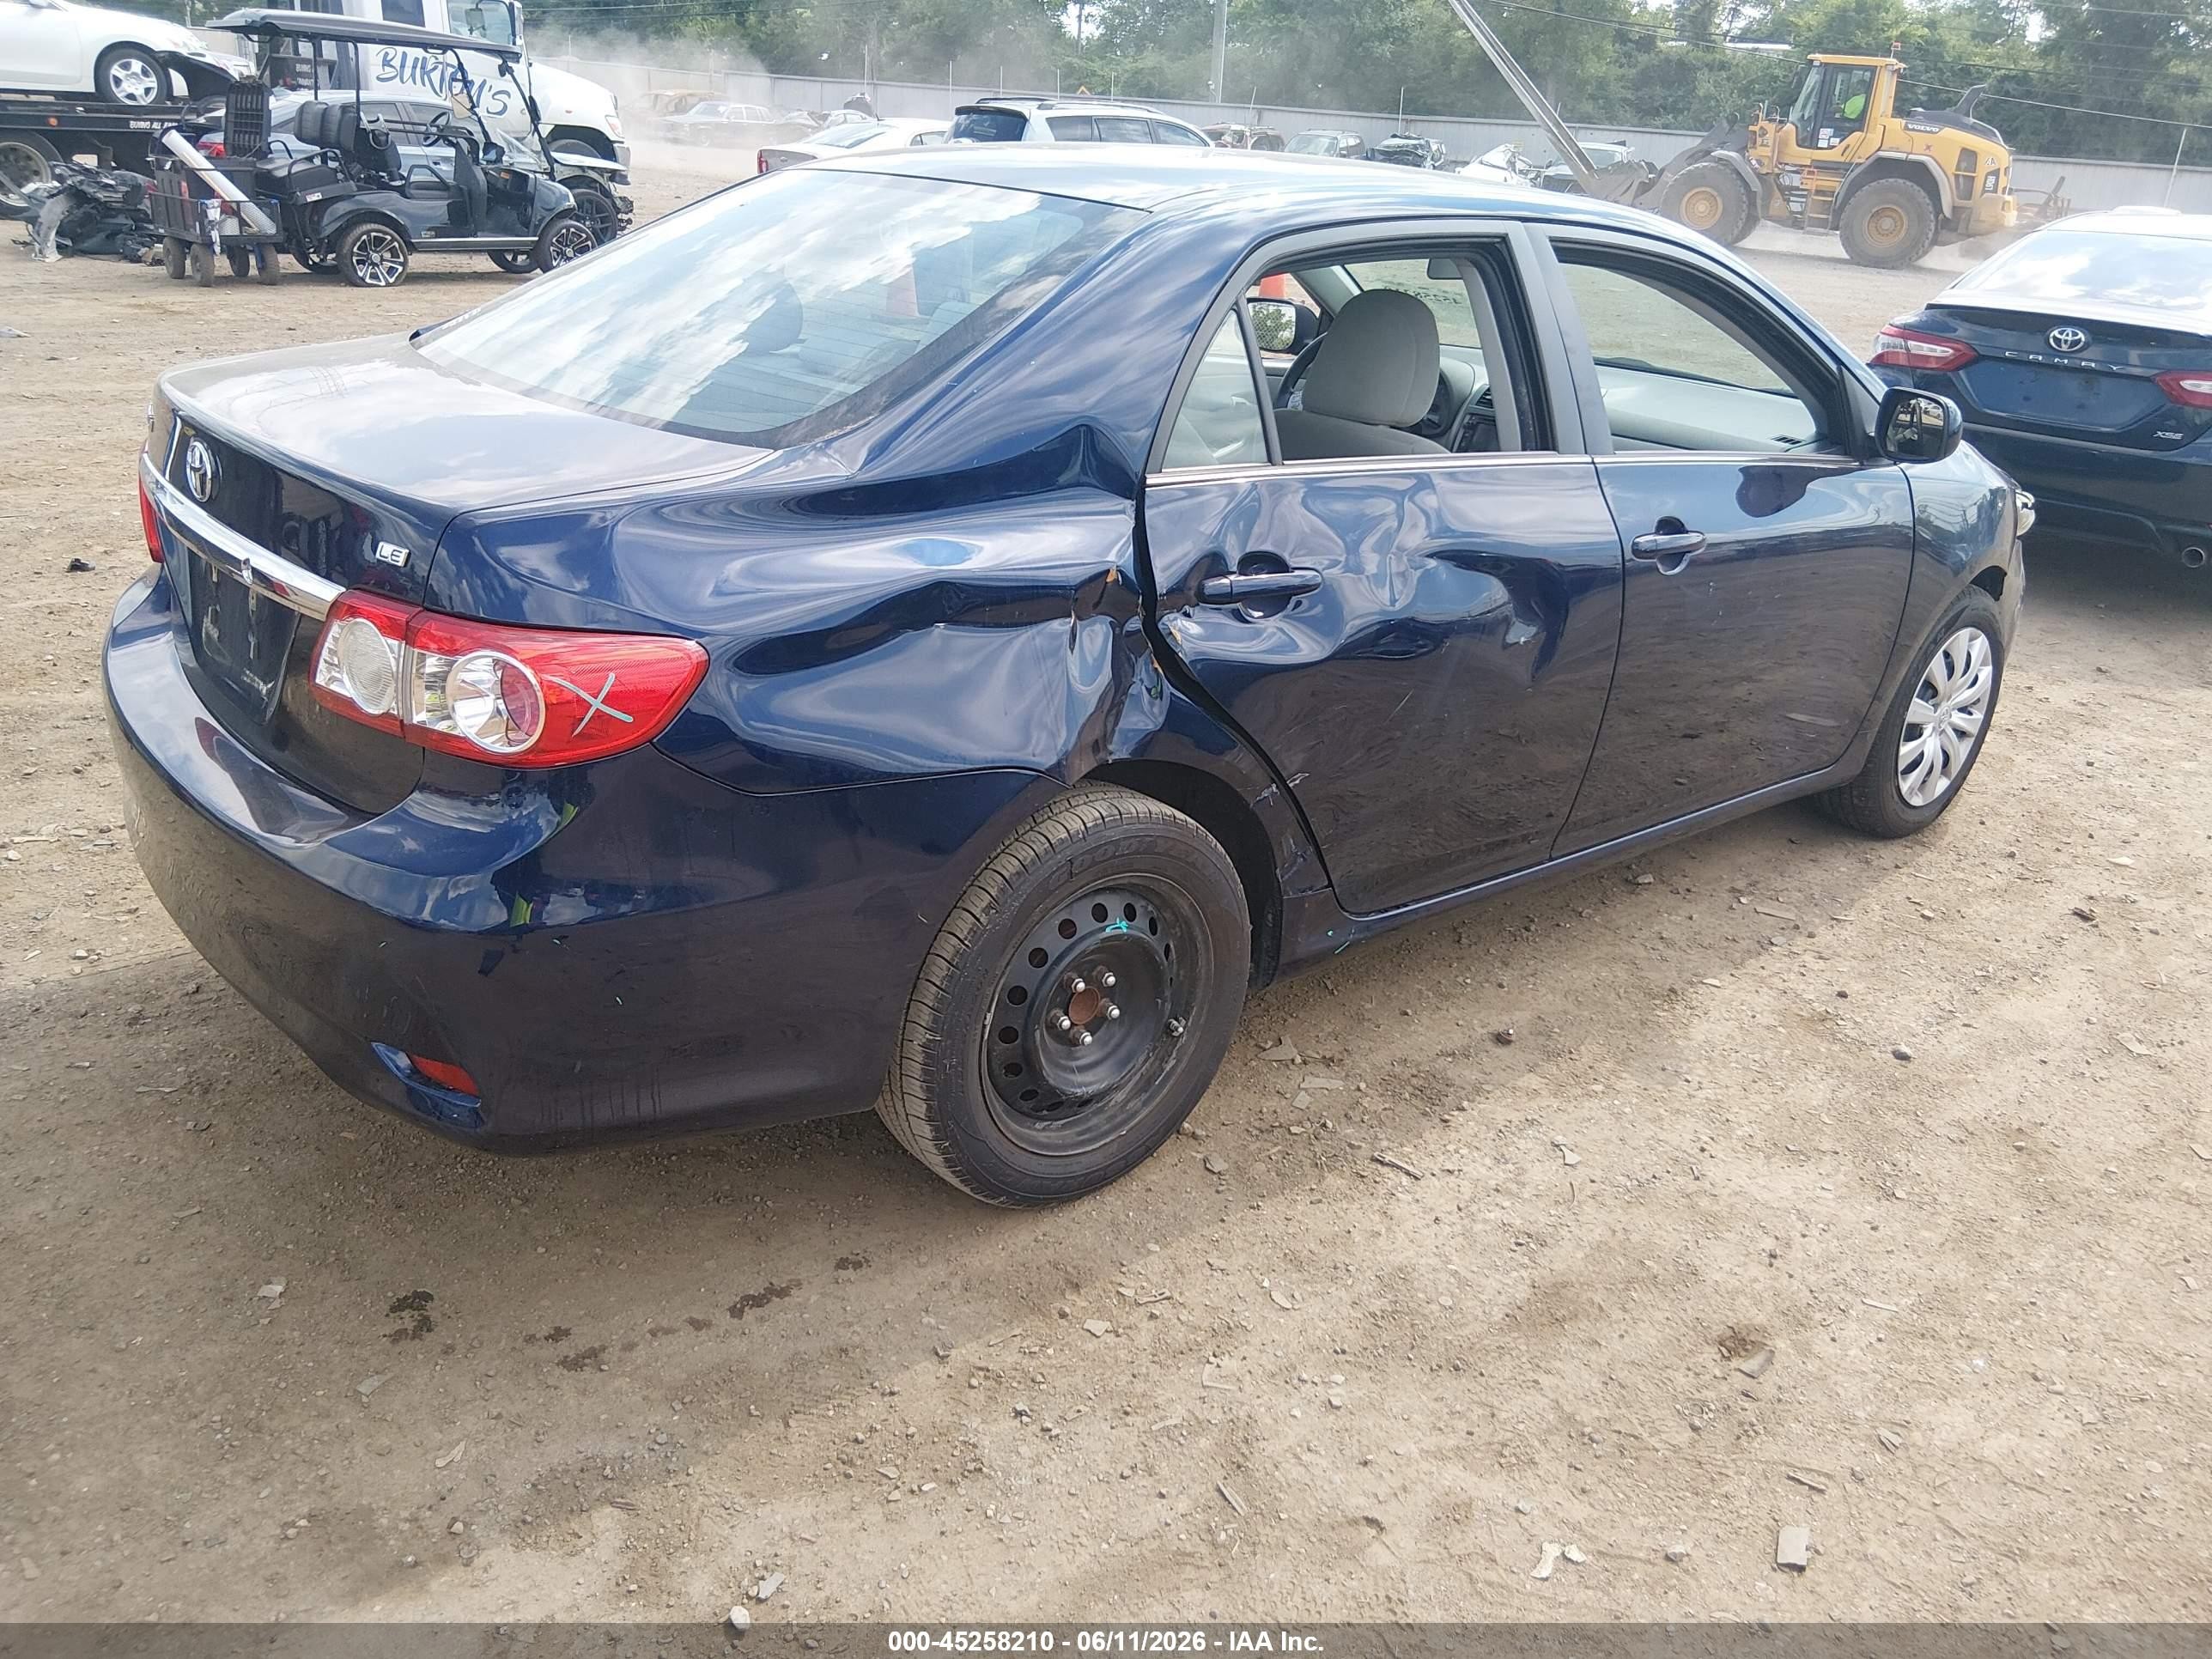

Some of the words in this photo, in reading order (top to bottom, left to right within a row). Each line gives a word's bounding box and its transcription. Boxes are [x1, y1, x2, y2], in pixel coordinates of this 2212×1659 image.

[1907, 124, 1941, 132] VOLVO
[2005, 351, 2124, 371] CAMRY
[2152, 430, 2185, 440] XSE
[379, 544, 404, 563] LE
